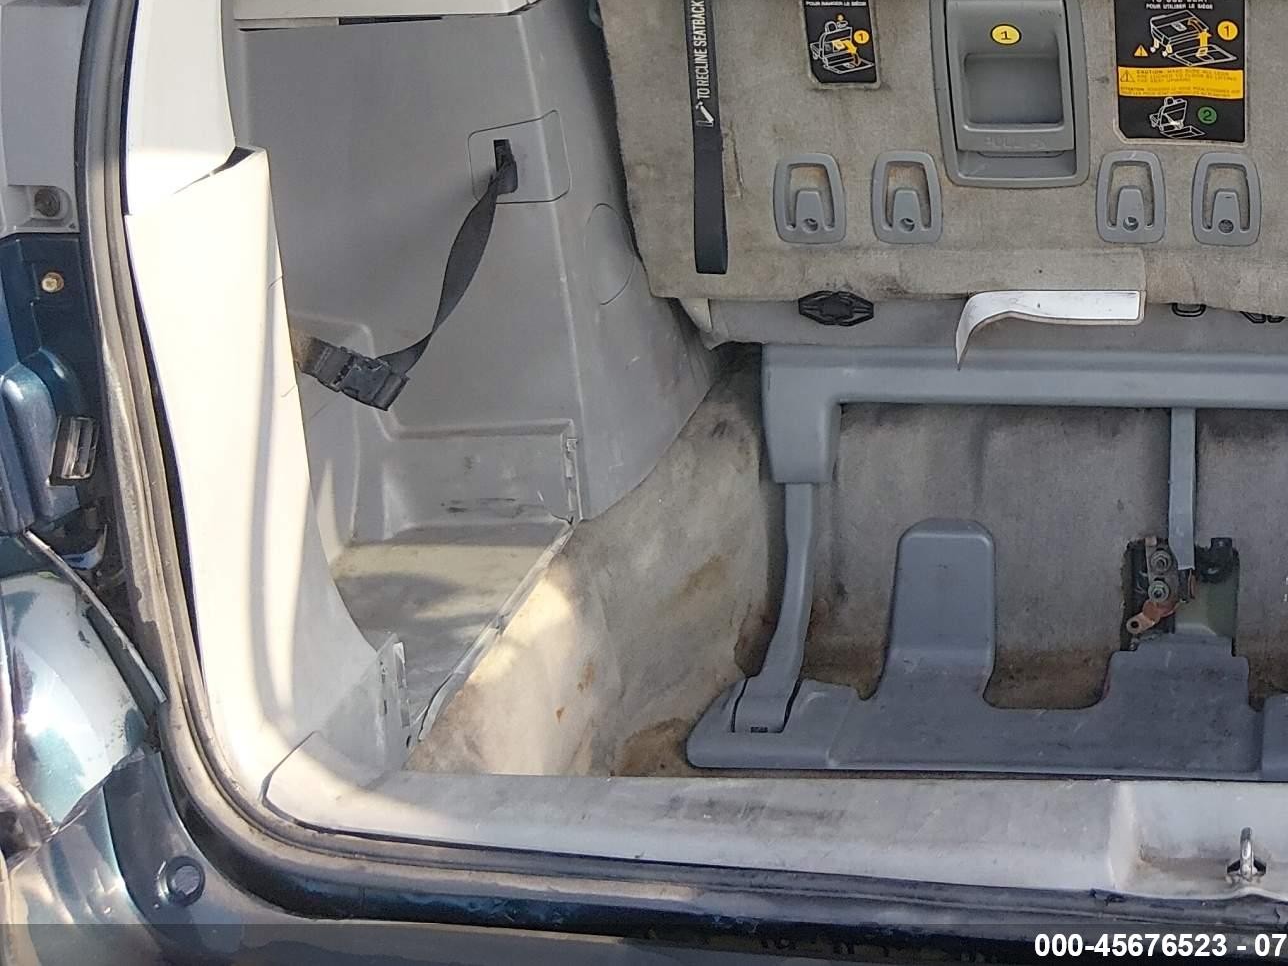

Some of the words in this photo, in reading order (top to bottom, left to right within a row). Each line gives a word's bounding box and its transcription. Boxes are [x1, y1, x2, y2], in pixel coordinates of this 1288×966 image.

[690, 0, 708, 48] SEATBACK
[1000, 30, 1012, 40] 1
[693, 48, 710, 87] RECLINE
[697, 87, 710, 99] TO
[1202, 109, 1212, 122] 2
